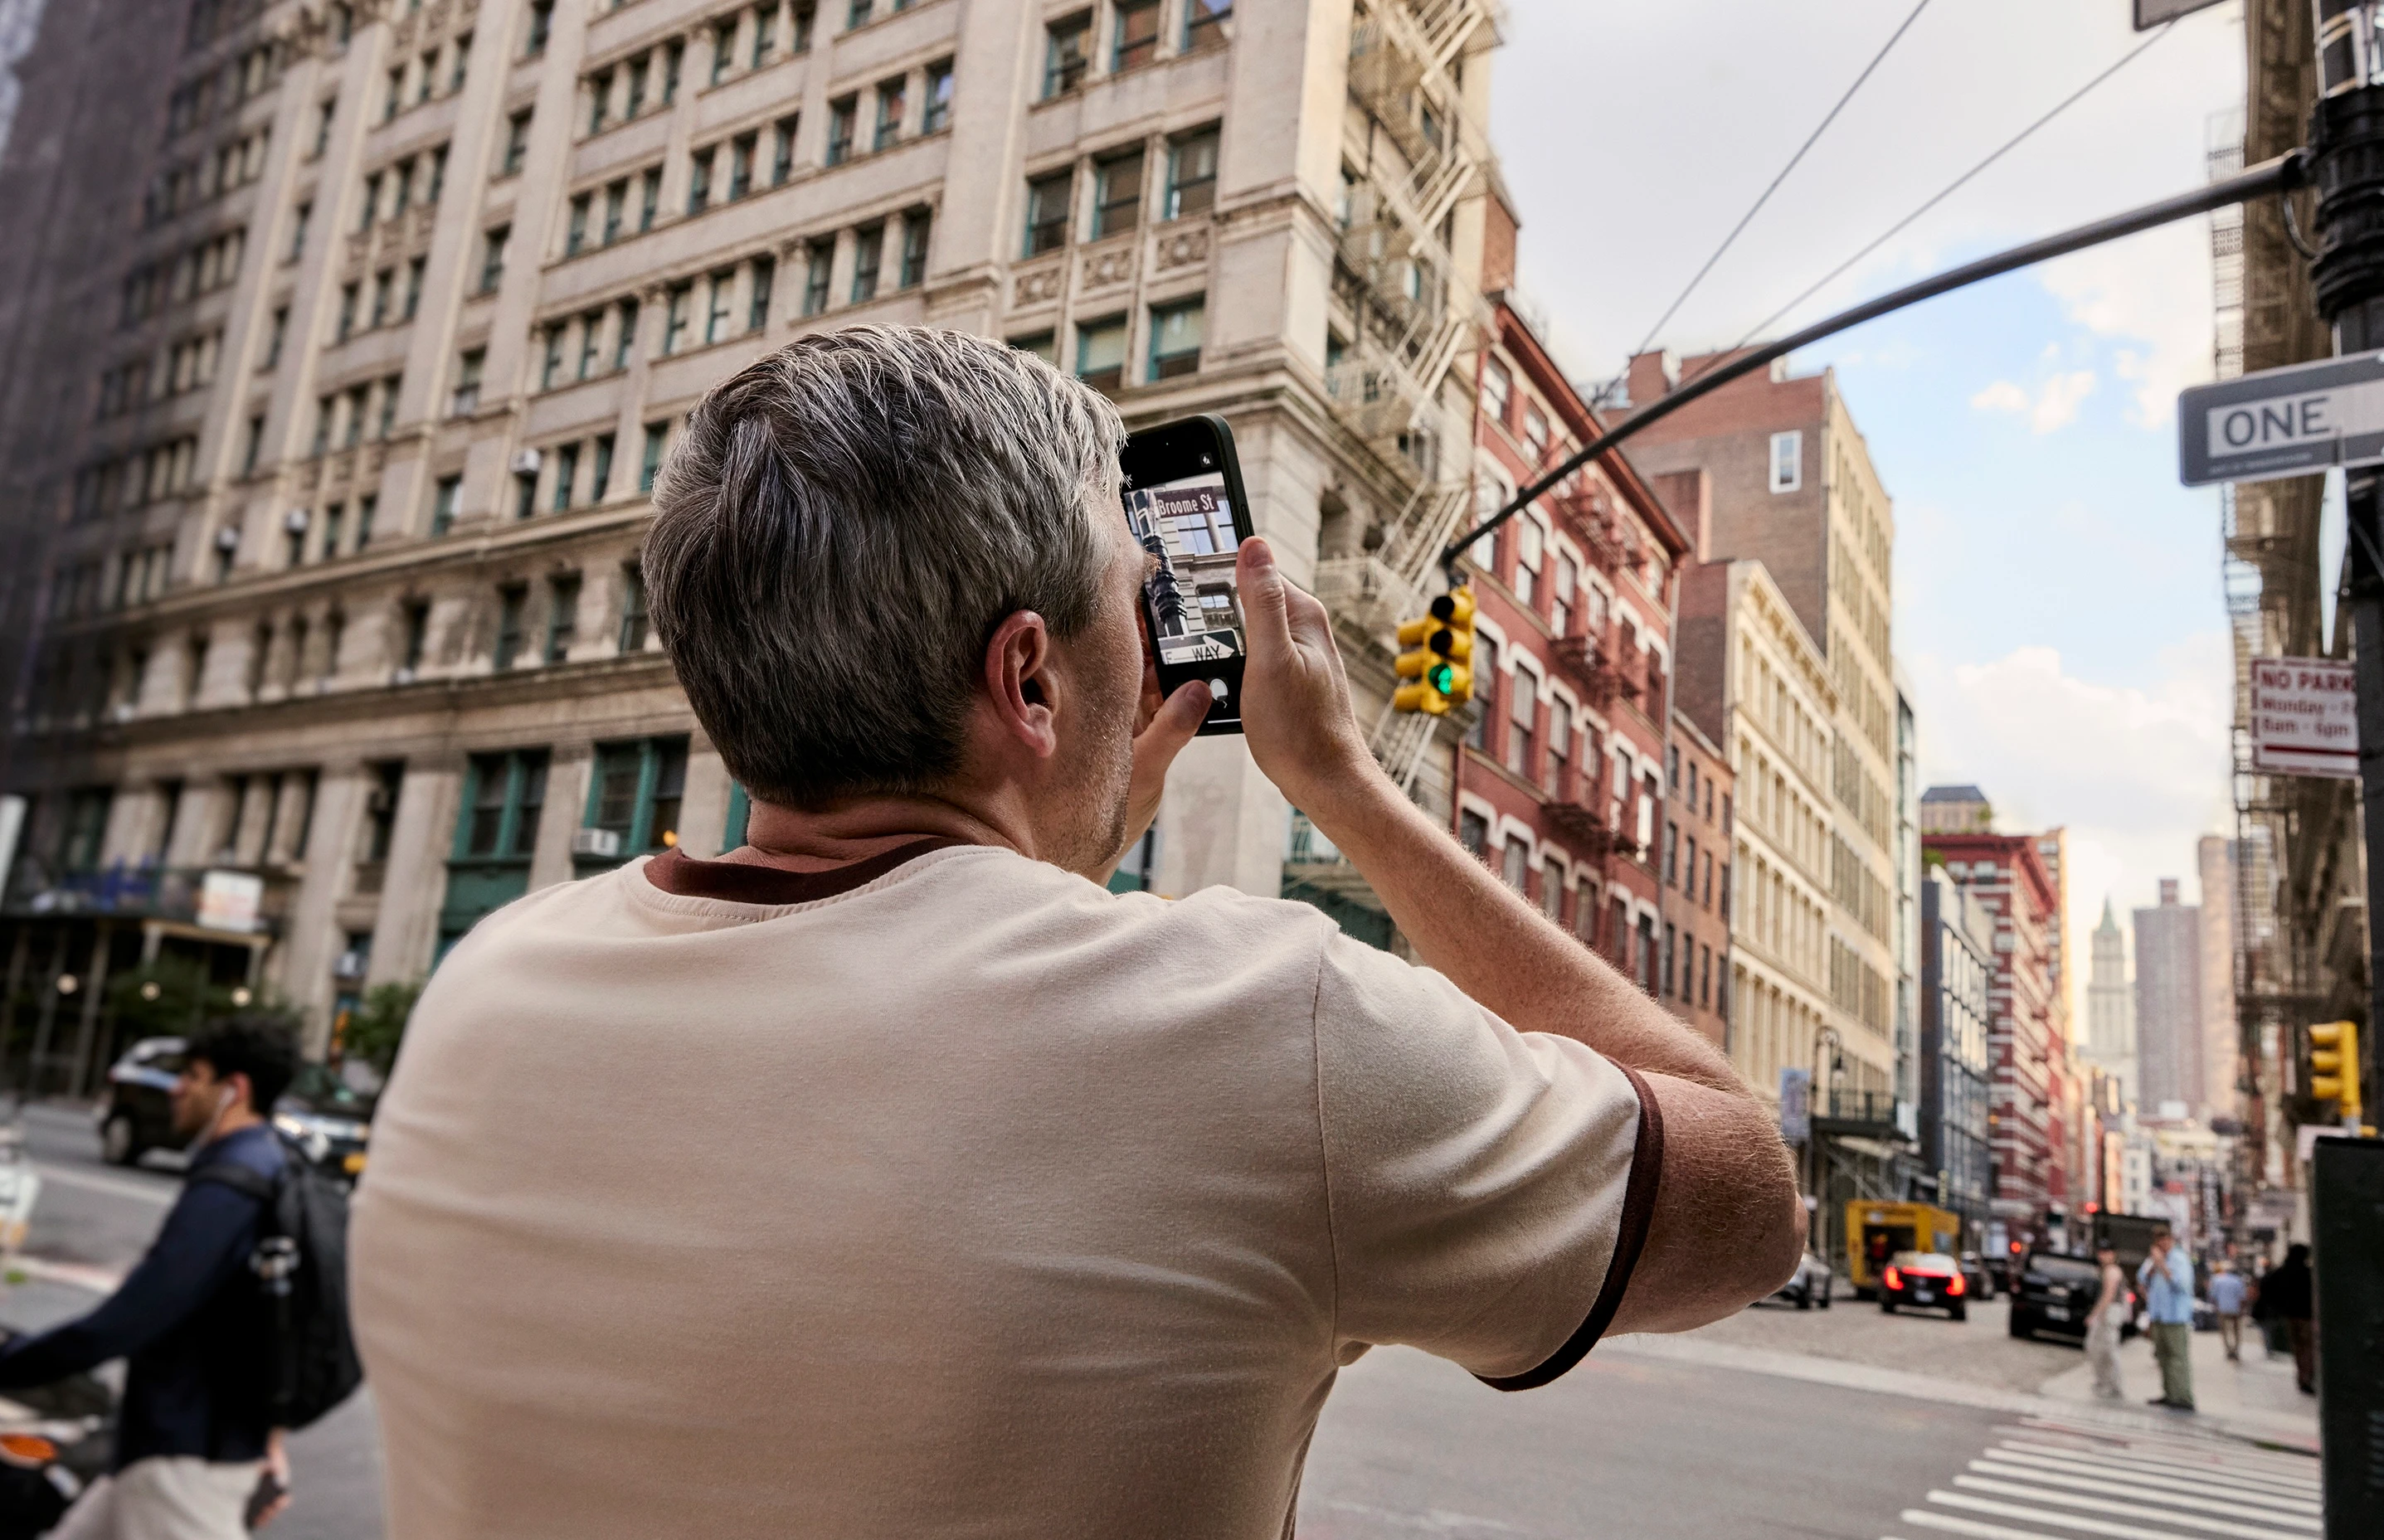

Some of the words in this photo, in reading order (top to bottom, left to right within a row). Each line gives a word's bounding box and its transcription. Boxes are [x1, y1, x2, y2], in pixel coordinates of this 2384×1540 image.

[2225, 396, 2330, 447] ONE
[1158, 498, 1199, 516] Broome
[1199, 493, 1214, 511] St
[1192, 644, 1219, 661] WAY
[2262, 670, 2291, 690] NO
[2262, 697, 2324, 717] Monday
